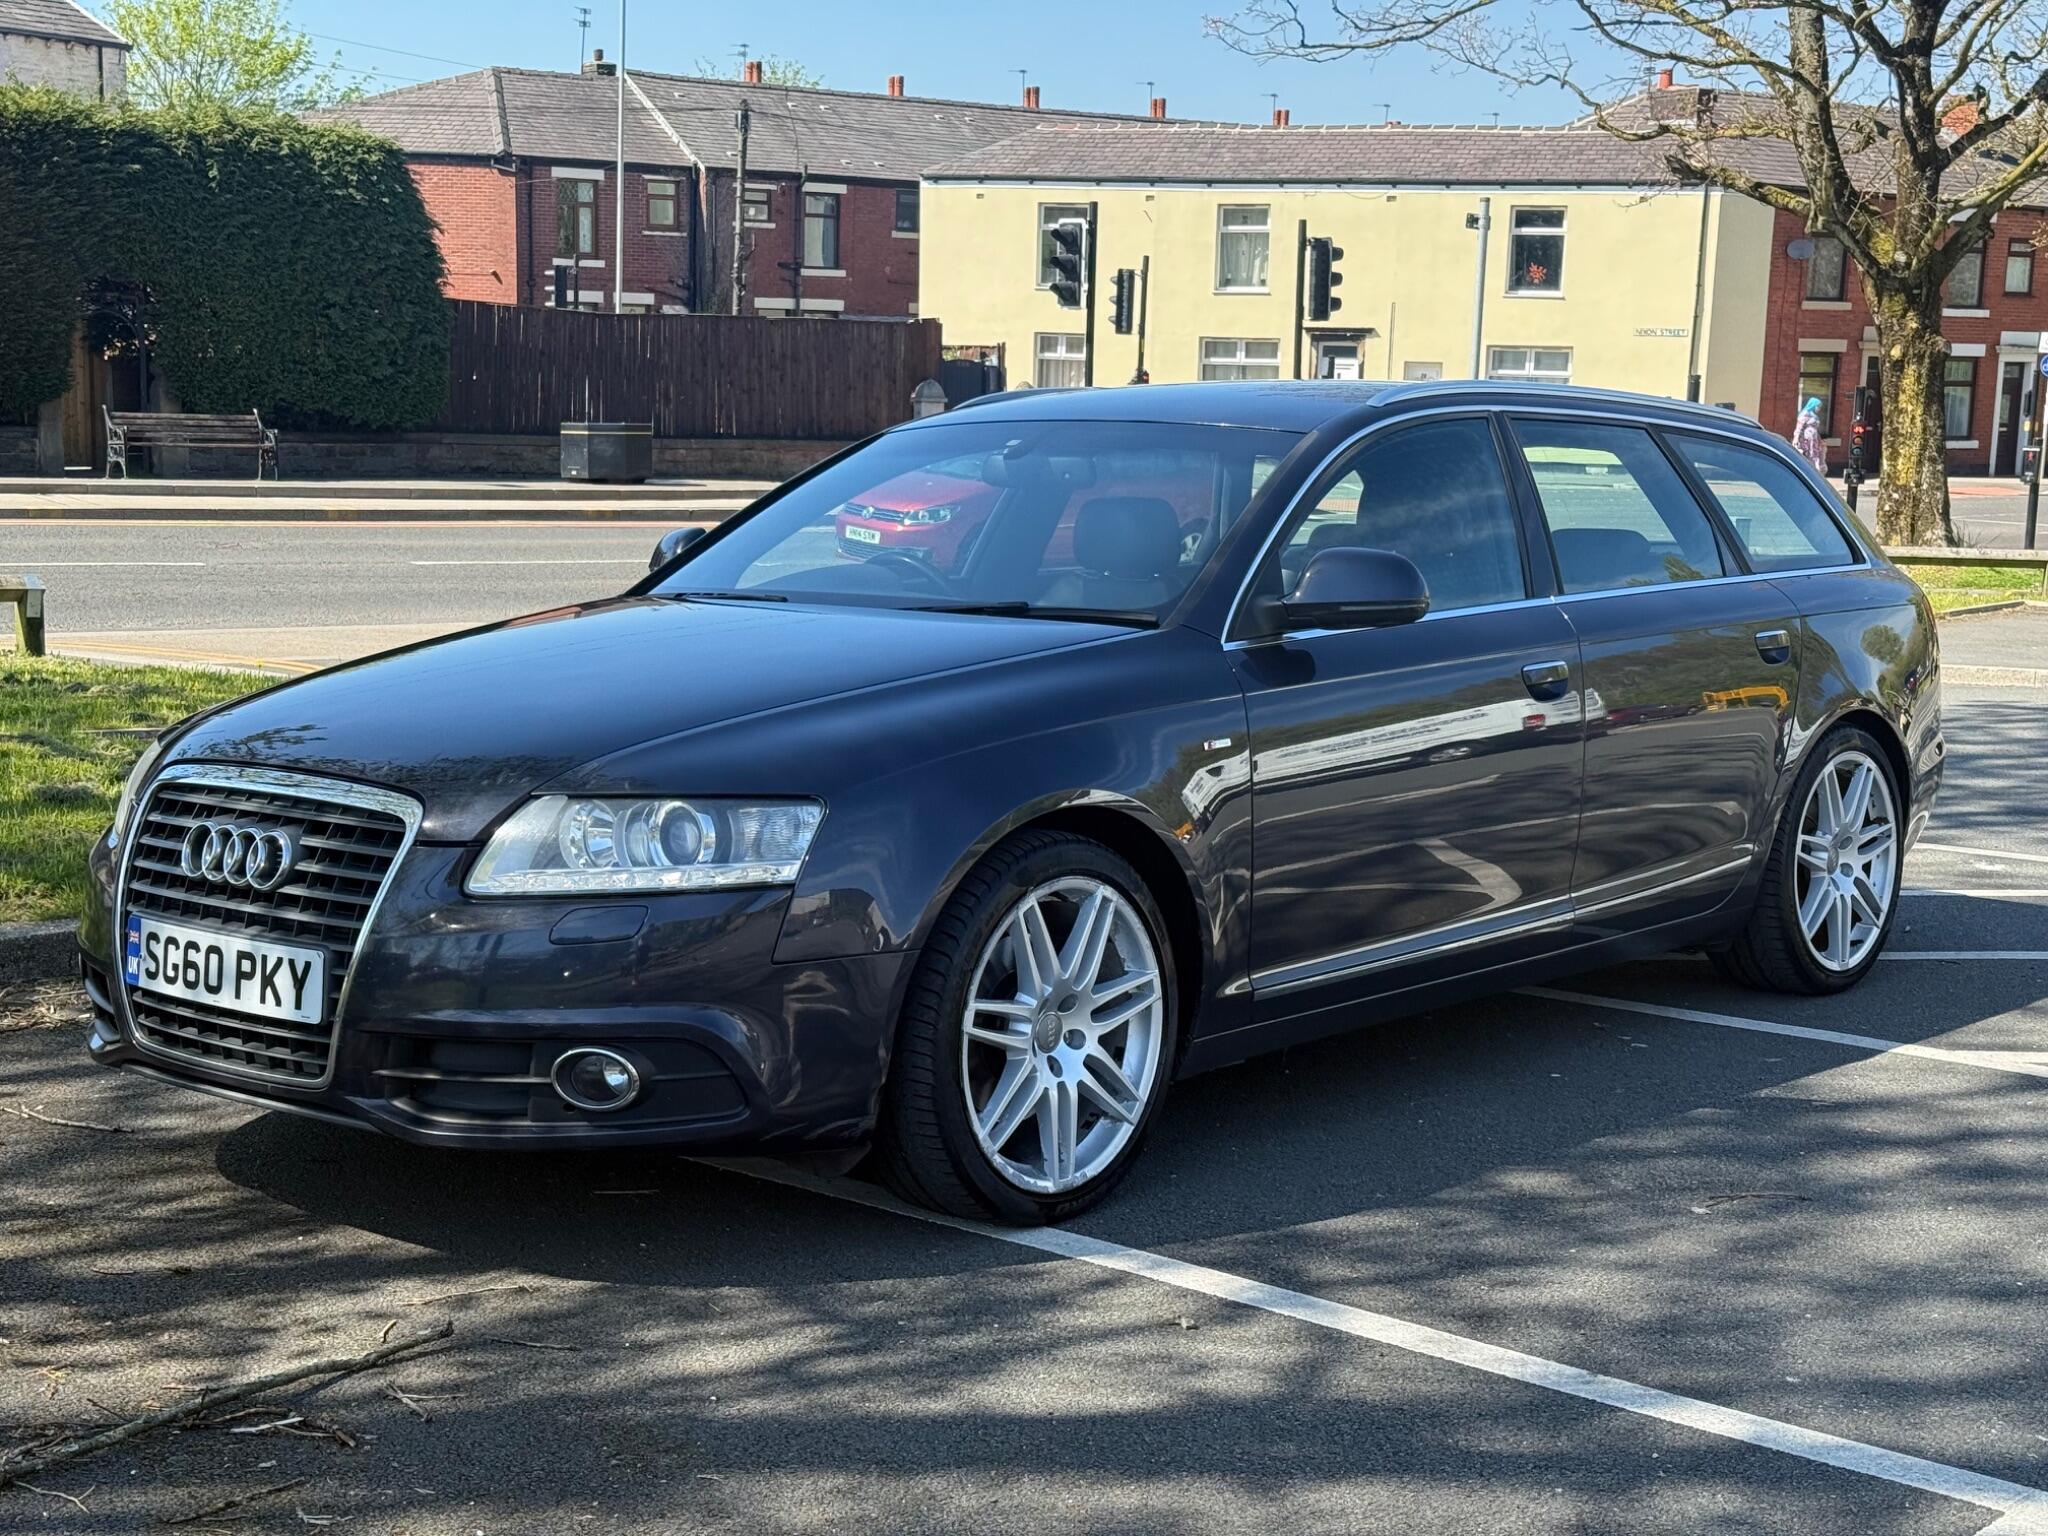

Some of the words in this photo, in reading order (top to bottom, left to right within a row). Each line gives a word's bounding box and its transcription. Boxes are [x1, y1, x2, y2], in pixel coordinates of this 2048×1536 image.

[1660, 328, 1686, 336] STREET
[128, 955, 139, 974] UK
[144, 931, 224, 995] SG60
[234, 950, 312, 1011] PKY
